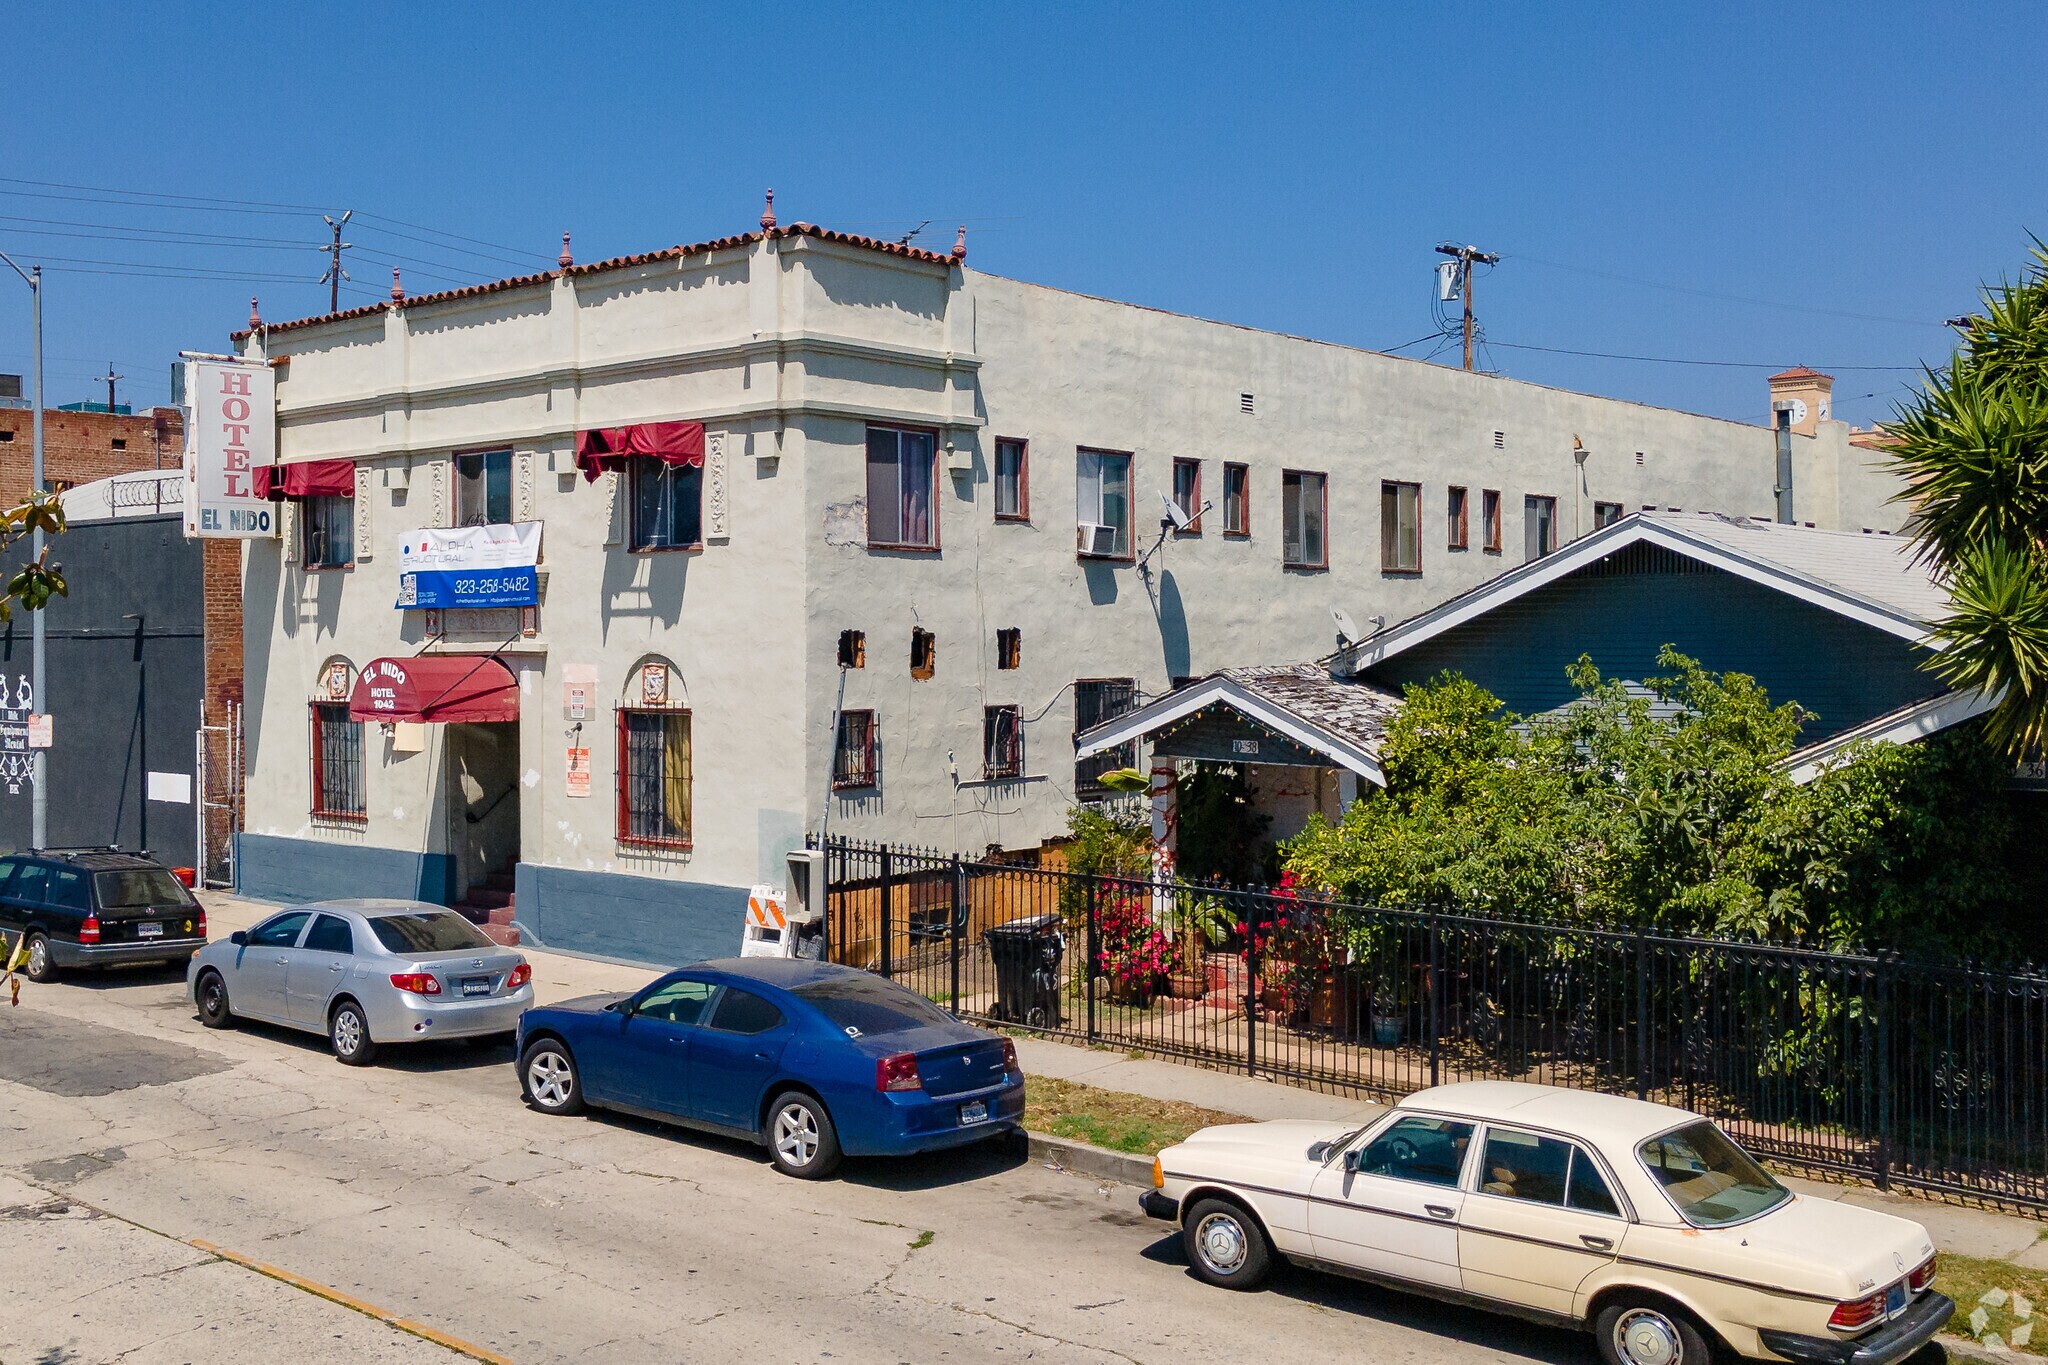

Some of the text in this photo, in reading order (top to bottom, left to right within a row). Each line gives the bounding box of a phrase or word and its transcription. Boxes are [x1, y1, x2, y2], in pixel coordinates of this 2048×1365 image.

[220, 371, 252, 498] HOTEL
[201, 508, 270, 533] EL NIDO
[430, 540, 473, 552] ALPHA
[454, 576, 529, 594] 323-258-5482
[363, 661, 406, 685] EL NIDO
[370, 687, 396, 698] HOTEL
[373, 699, 395, 709] 1042
